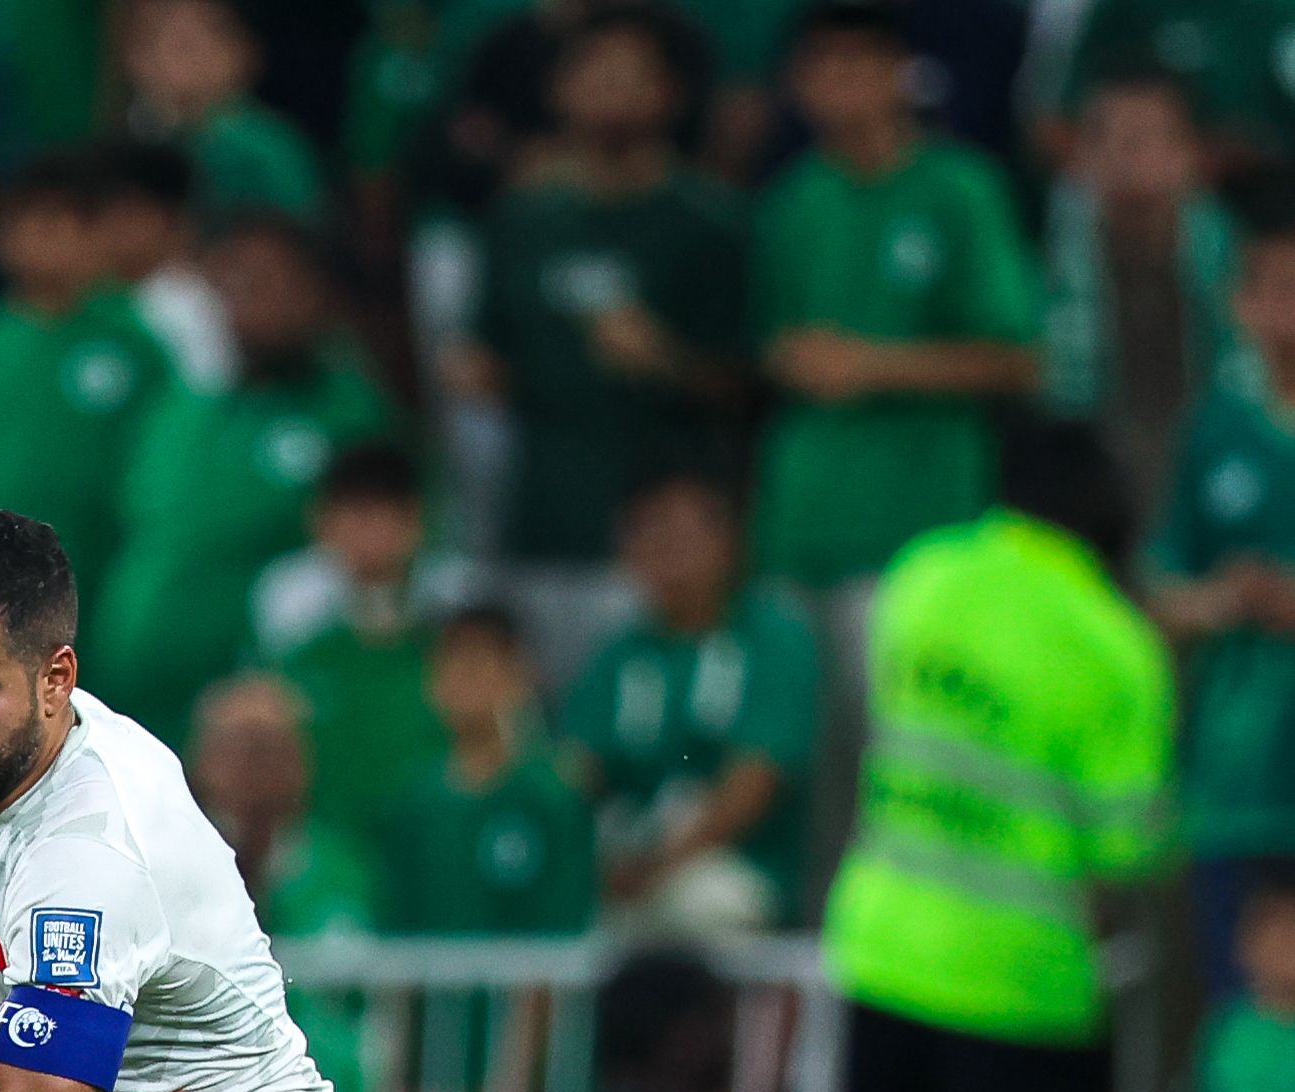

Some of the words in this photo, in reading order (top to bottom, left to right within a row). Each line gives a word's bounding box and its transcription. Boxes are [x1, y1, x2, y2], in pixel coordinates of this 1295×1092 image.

[43, 920, 86, 935] FOOTBALL
[43, 933, 86, 951] UNITES
[41, 948, 57, 962] the
[57, 949, 87, 966] World
[55, 965, 73, 973] FIFA
